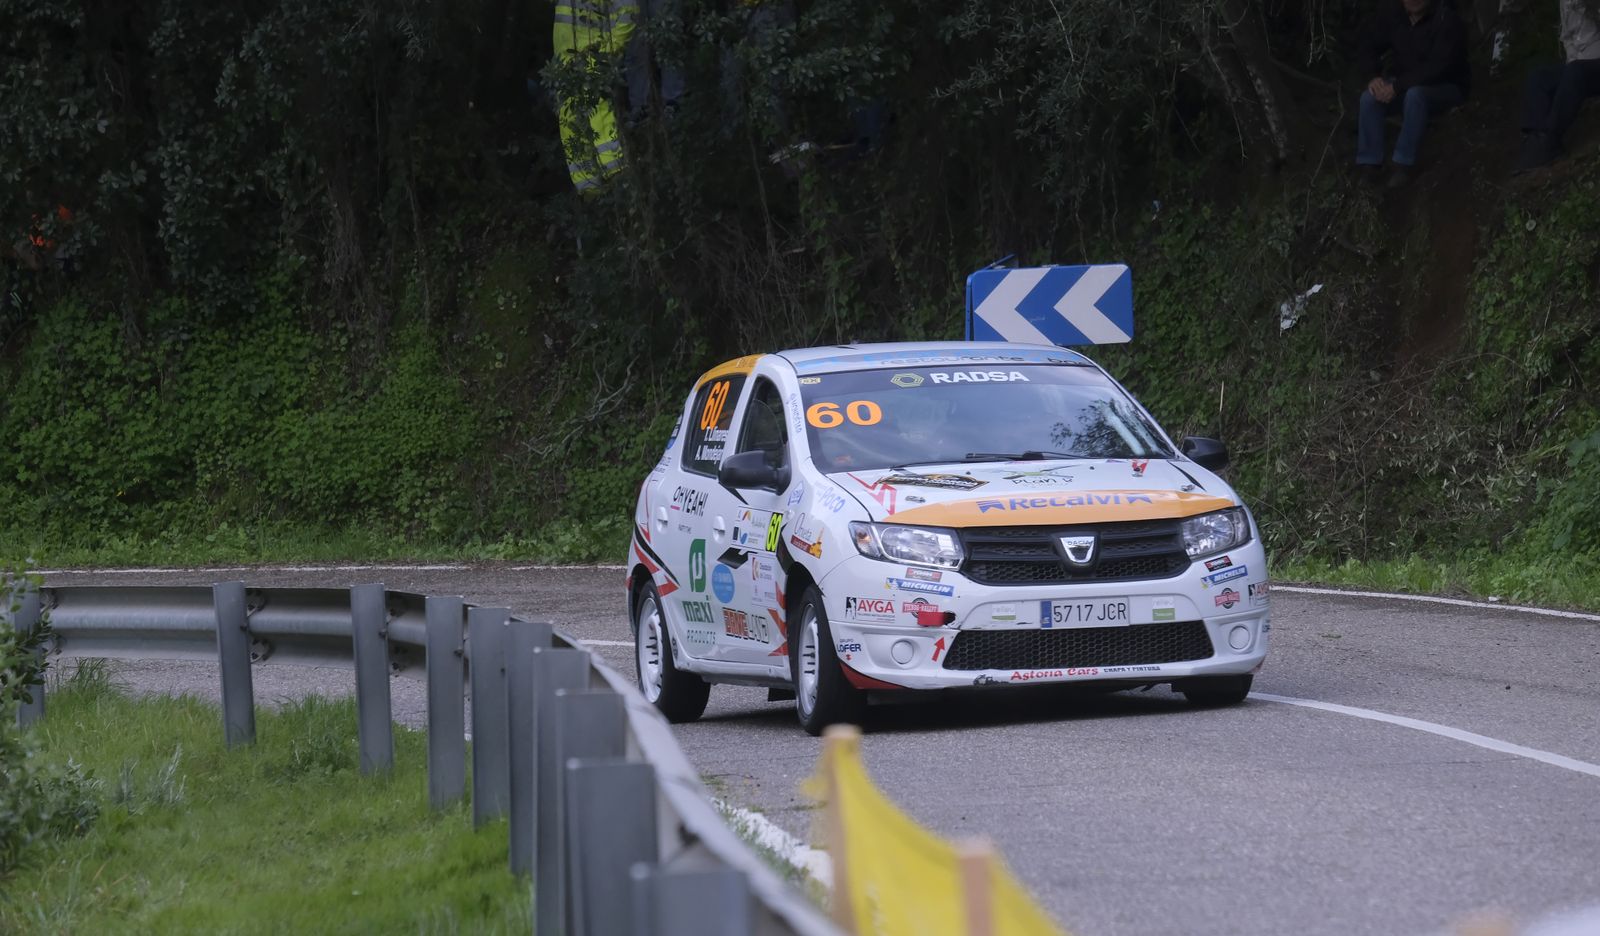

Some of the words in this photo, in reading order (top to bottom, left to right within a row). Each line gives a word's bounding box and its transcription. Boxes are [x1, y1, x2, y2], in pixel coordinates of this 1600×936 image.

[929, 371, 1030, 384] RADSA
[700, 380, 730, 430] 60
[806, 400, 883, 429] 60
[1009, 493, 1121, 511] Recalvi
[766, 512, 783, 552] 60
[1214, 566, 1246, 582] MICHELIN
[901, 581, 951, 593] MICHELIN
[682, 595, 714, 623] maxi
[857, 599, 895, 613] AYGA
[1053, 604, 1094, 623] 5717
[1097, 602, 1127, 621] JCR
[686, 629, 716, 645] PRODUCTS
[836, 643, 861, 653] LOFER
[1010, 669, 1063, 681] Astoria
[1067, 666, 1099, 677] Cars
